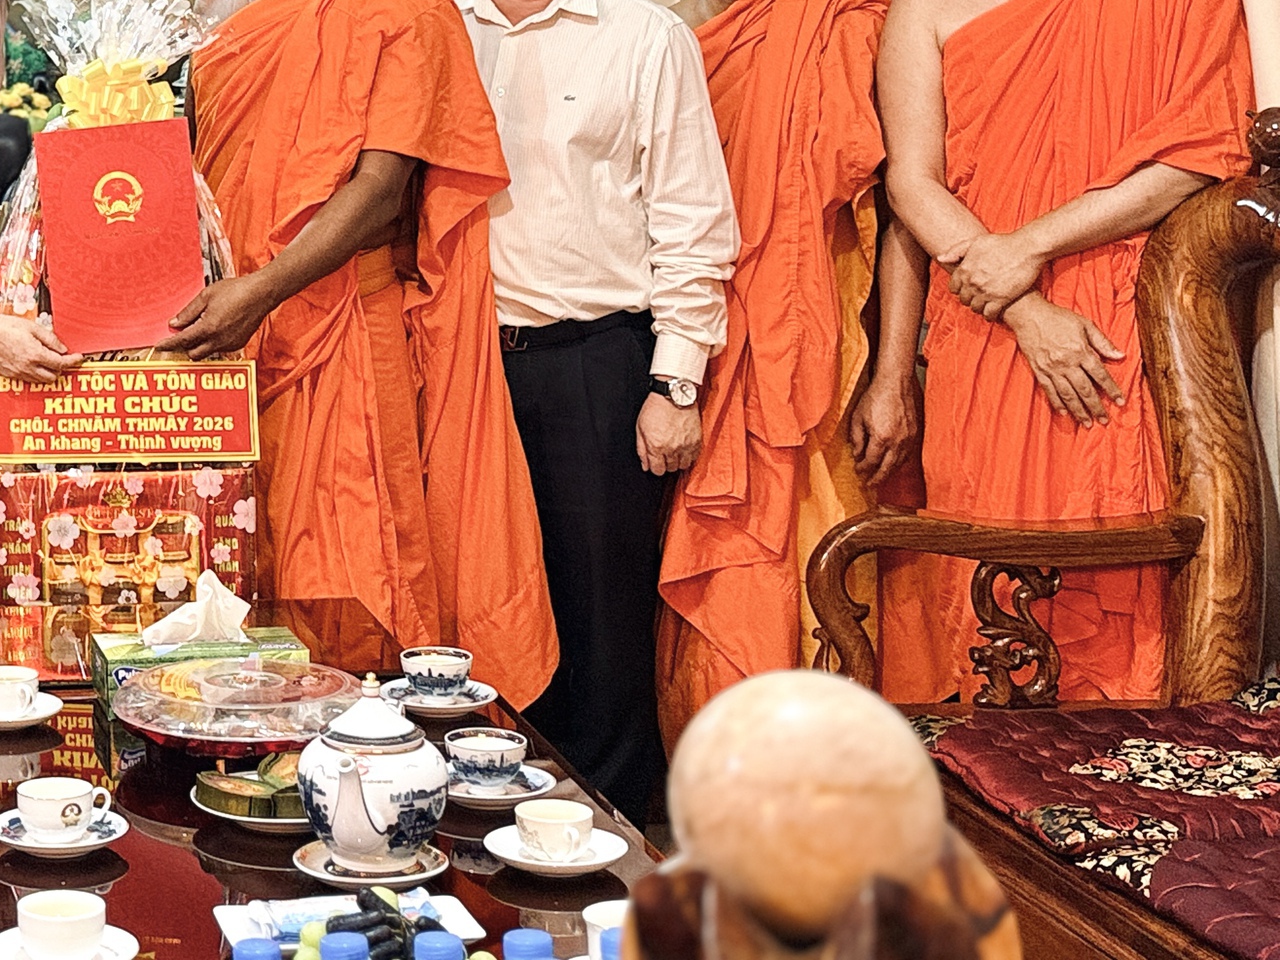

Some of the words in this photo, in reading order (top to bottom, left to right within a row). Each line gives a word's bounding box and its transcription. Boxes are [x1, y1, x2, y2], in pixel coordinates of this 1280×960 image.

[77, 371, 117, 394] TỘC
[120, 370, 149, 391] VÀ
[153, 370, 196, 391] TÔN
[200, 370, 247, 390] GIÁO
[44, 393, 117, 415] KÍNH
[124, 393, 198, 414] CHÚC
[9, 416, 54, 433] CHÔL
[57, 415, 122, 433] CHNĂM
[125, 414, 189, 432] THMÂY
[193, 416, 235, 431] 2026
[22, 435, 46, 451] An
[50, 434, 102, 453] khang
[117, 434, 167, 452] Thịnh
[170, 436, 223, 452] vượng
